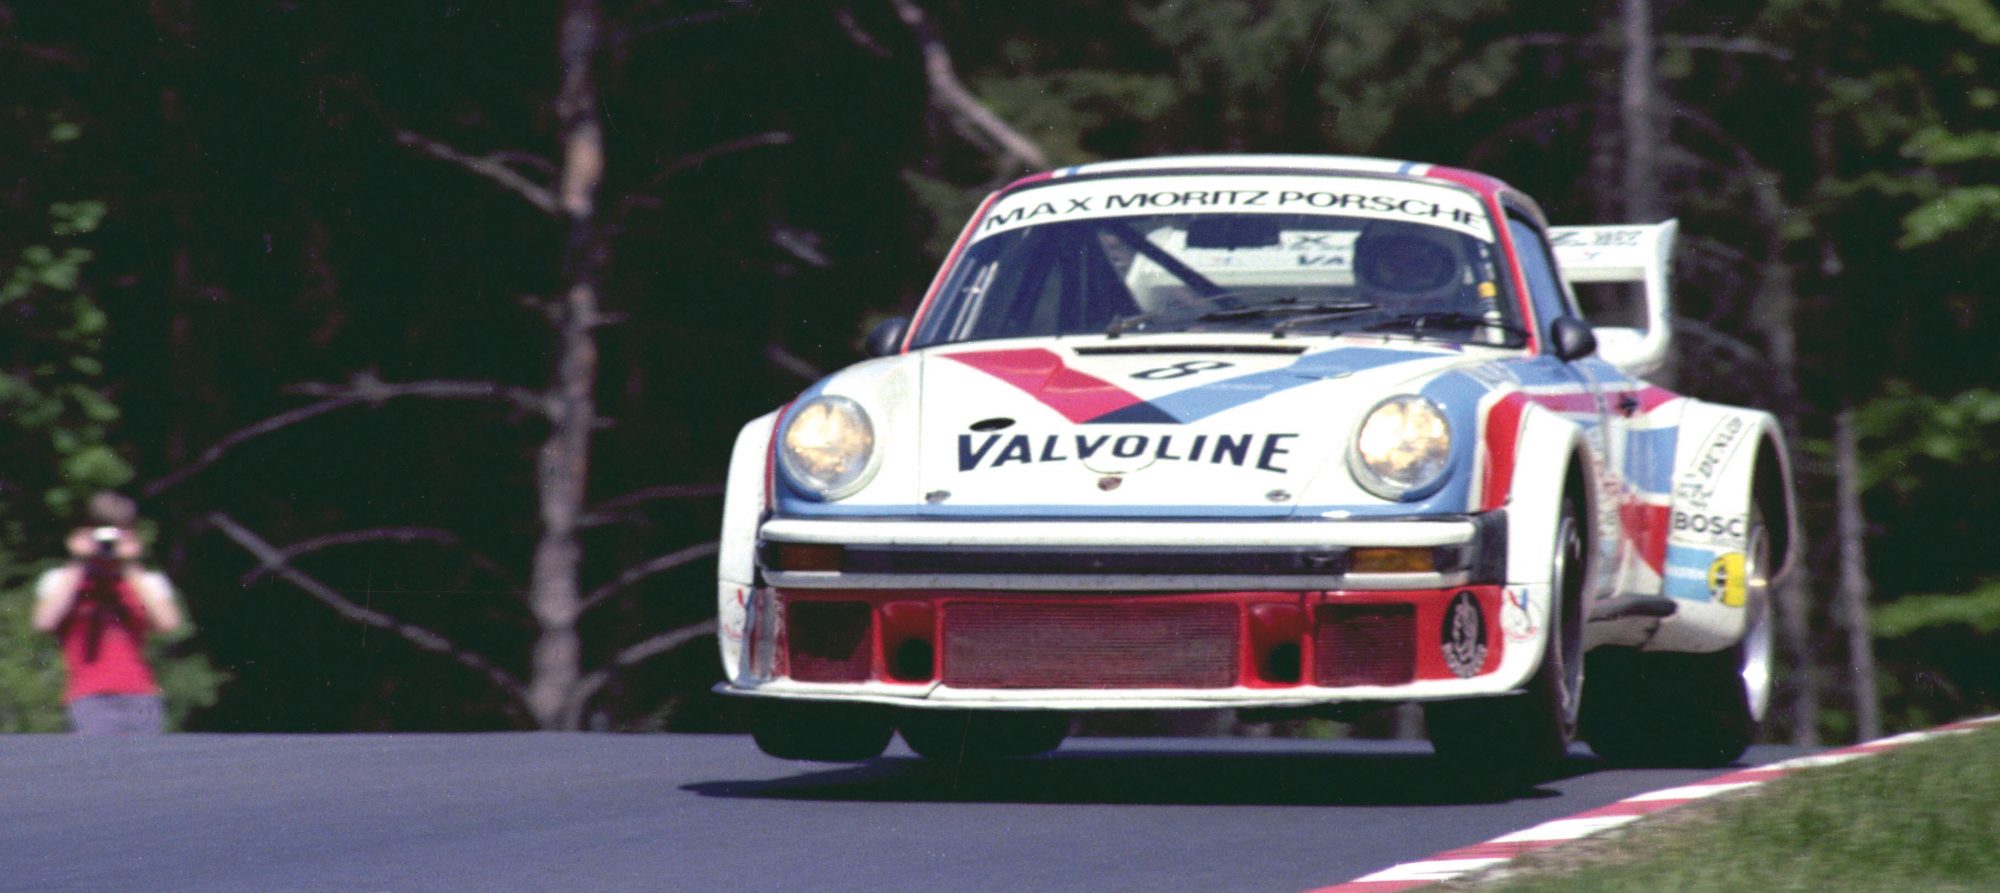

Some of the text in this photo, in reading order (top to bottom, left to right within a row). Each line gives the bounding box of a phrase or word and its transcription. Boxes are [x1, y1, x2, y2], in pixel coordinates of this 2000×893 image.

[984, 189, 1488, 231] MAX MORITZ PORSCHE
[1129, 360, 1237, 380] 8
[957, 432, 1300, 474] VALVOLINE
[1673, 510, 1745, 538] BOSC
